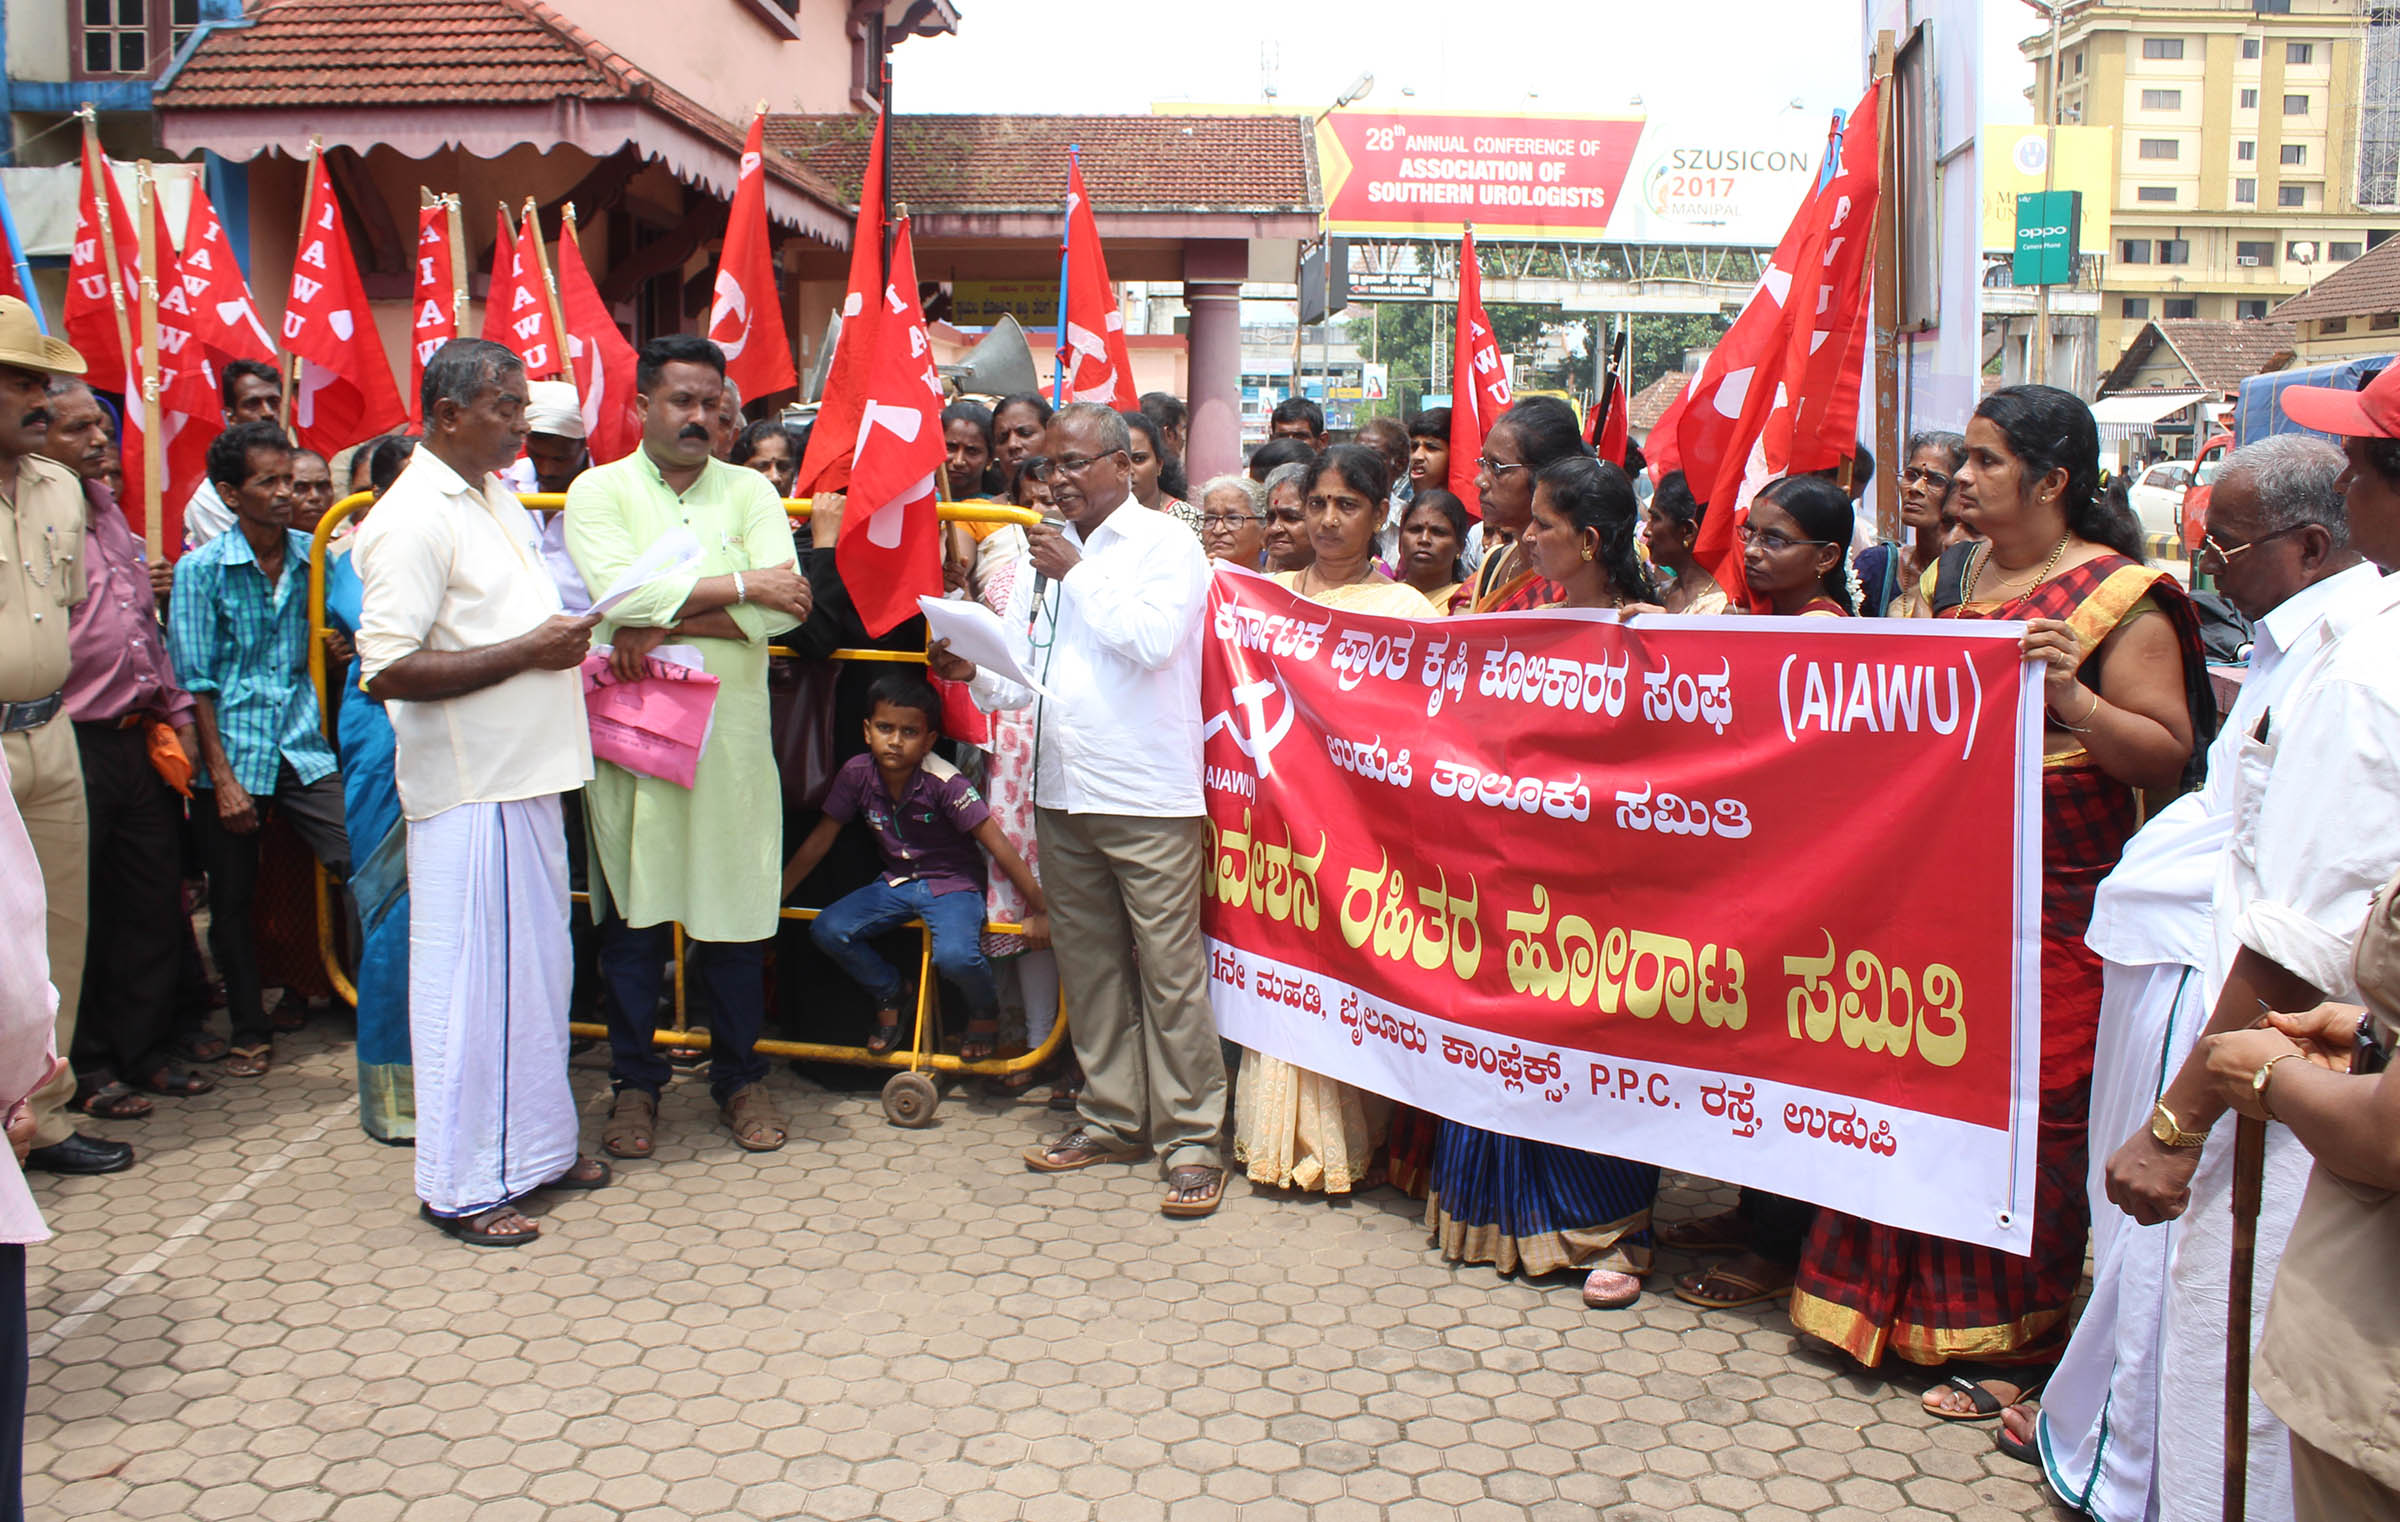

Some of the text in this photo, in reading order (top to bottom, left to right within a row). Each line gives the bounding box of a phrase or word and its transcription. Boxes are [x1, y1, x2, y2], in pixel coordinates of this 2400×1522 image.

[1365, 124, 1601, 156] 28th ANNUAL CONFERENCE OF
[1399, 158, 1567, 182] ASSOCIATION OF
[1672, 149, 1808, 172] SZUSICON
[1367, 181, 1606, 208] SOUTHERN UROLOGISTS
[1672, 176, 1736, 198] 2017
[1672, 203, 1743, 217] MANIPAL
[1214, 591, 1982, 761] ಕರ್ನಾಟಕ ಪ್ರಾಂತ ಕೃಷಿ ಕೂಲಿಕಾರರ ಸಂಘ (AIAWU)
[1203, 763, 1256, 806] AIAWU)
[1326, 734, 1753, 840] ಉಡುಪಿ ತಾಲೂಕು ಸಮಿತಿ
[1339, 844, 1483, 981] ರಹಿತರ
[1505, 883, 1749, 1032] ಹೋರಾಟ
[1783, 926, 1968, 1067] ಸಮಿತಿ
[1256, 966, 1327, 1022] ಮಹಡಿ,
[1339, 991, 1428, 1055] ಬೈಲೂರು
[1590, 1063, 1681, 1110] P.P.C.
[1699, 1079, 1763, 1138] ರಸ್ತೆ,
[1783, 1099, 1898, 1158] ಉಡುಪಿ
